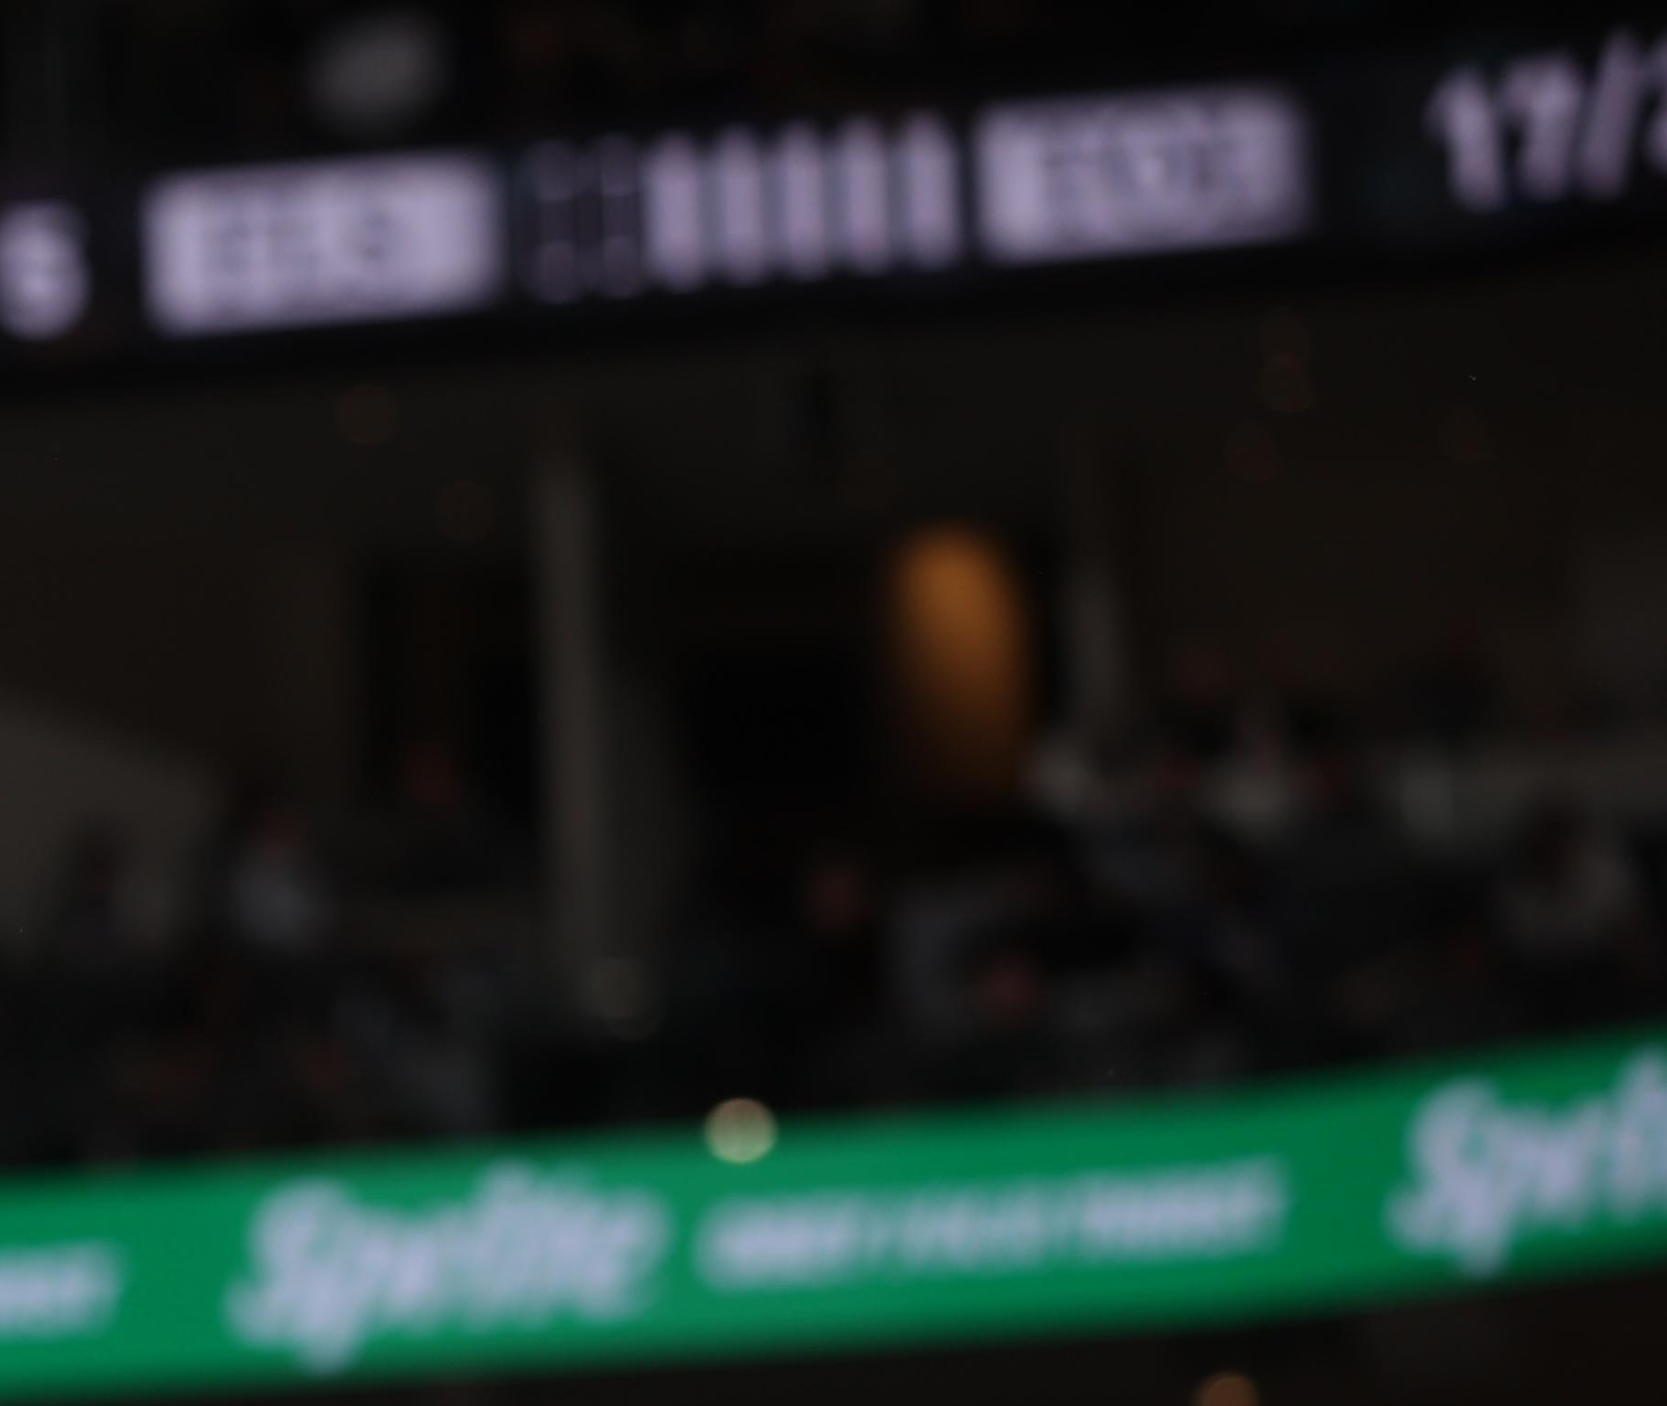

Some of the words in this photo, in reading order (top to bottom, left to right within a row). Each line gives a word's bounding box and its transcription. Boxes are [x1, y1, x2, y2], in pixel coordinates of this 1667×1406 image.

[1422, 38, 1667, 208] 17/
[1387, 1050, 1667, 1272] Spri
[231, 1163, 655, 1370] Sprite
